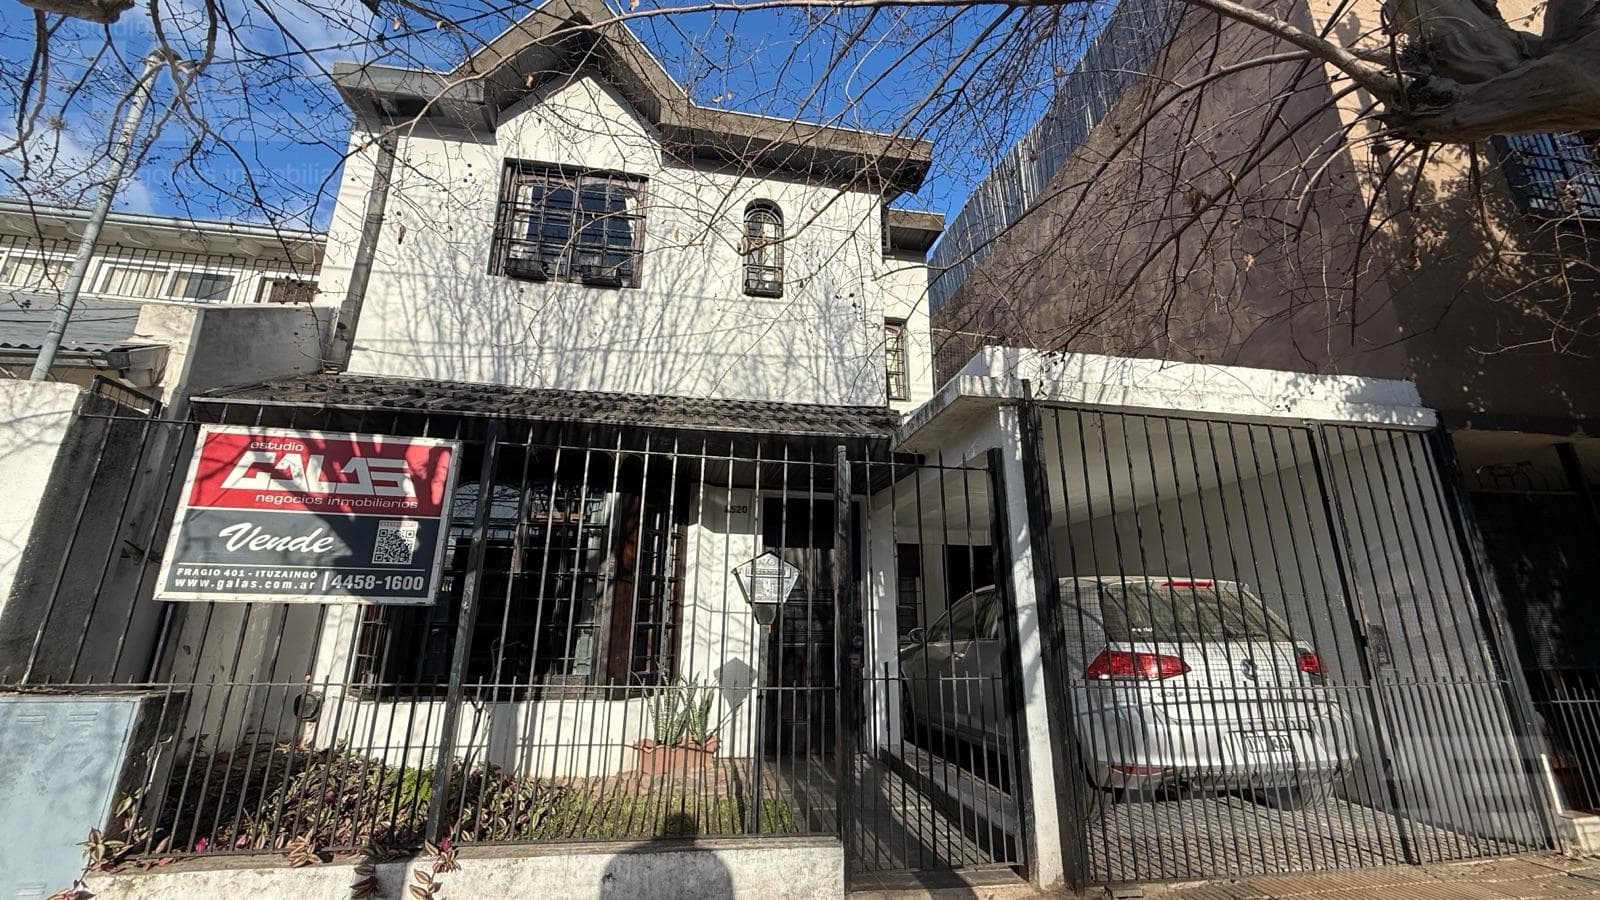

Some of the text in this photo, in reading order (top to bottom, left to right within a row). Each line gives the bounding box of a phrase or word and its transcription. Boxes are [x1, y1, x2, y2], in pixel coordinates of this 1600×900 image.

[249, 441, 304, 452] estudio
[220, 451, 417, 496] GALAS
[255, 493, 418, 509] negocios inmobiliarios
[218, 521, 334, 554] Vende
[177, 568, 221, 577] FRAGIO
[223, 569, 245, 577] 401
[174, 578, 316, 590] www.galas.com.ar
[331, 574, 424, 591] 4458-1600
